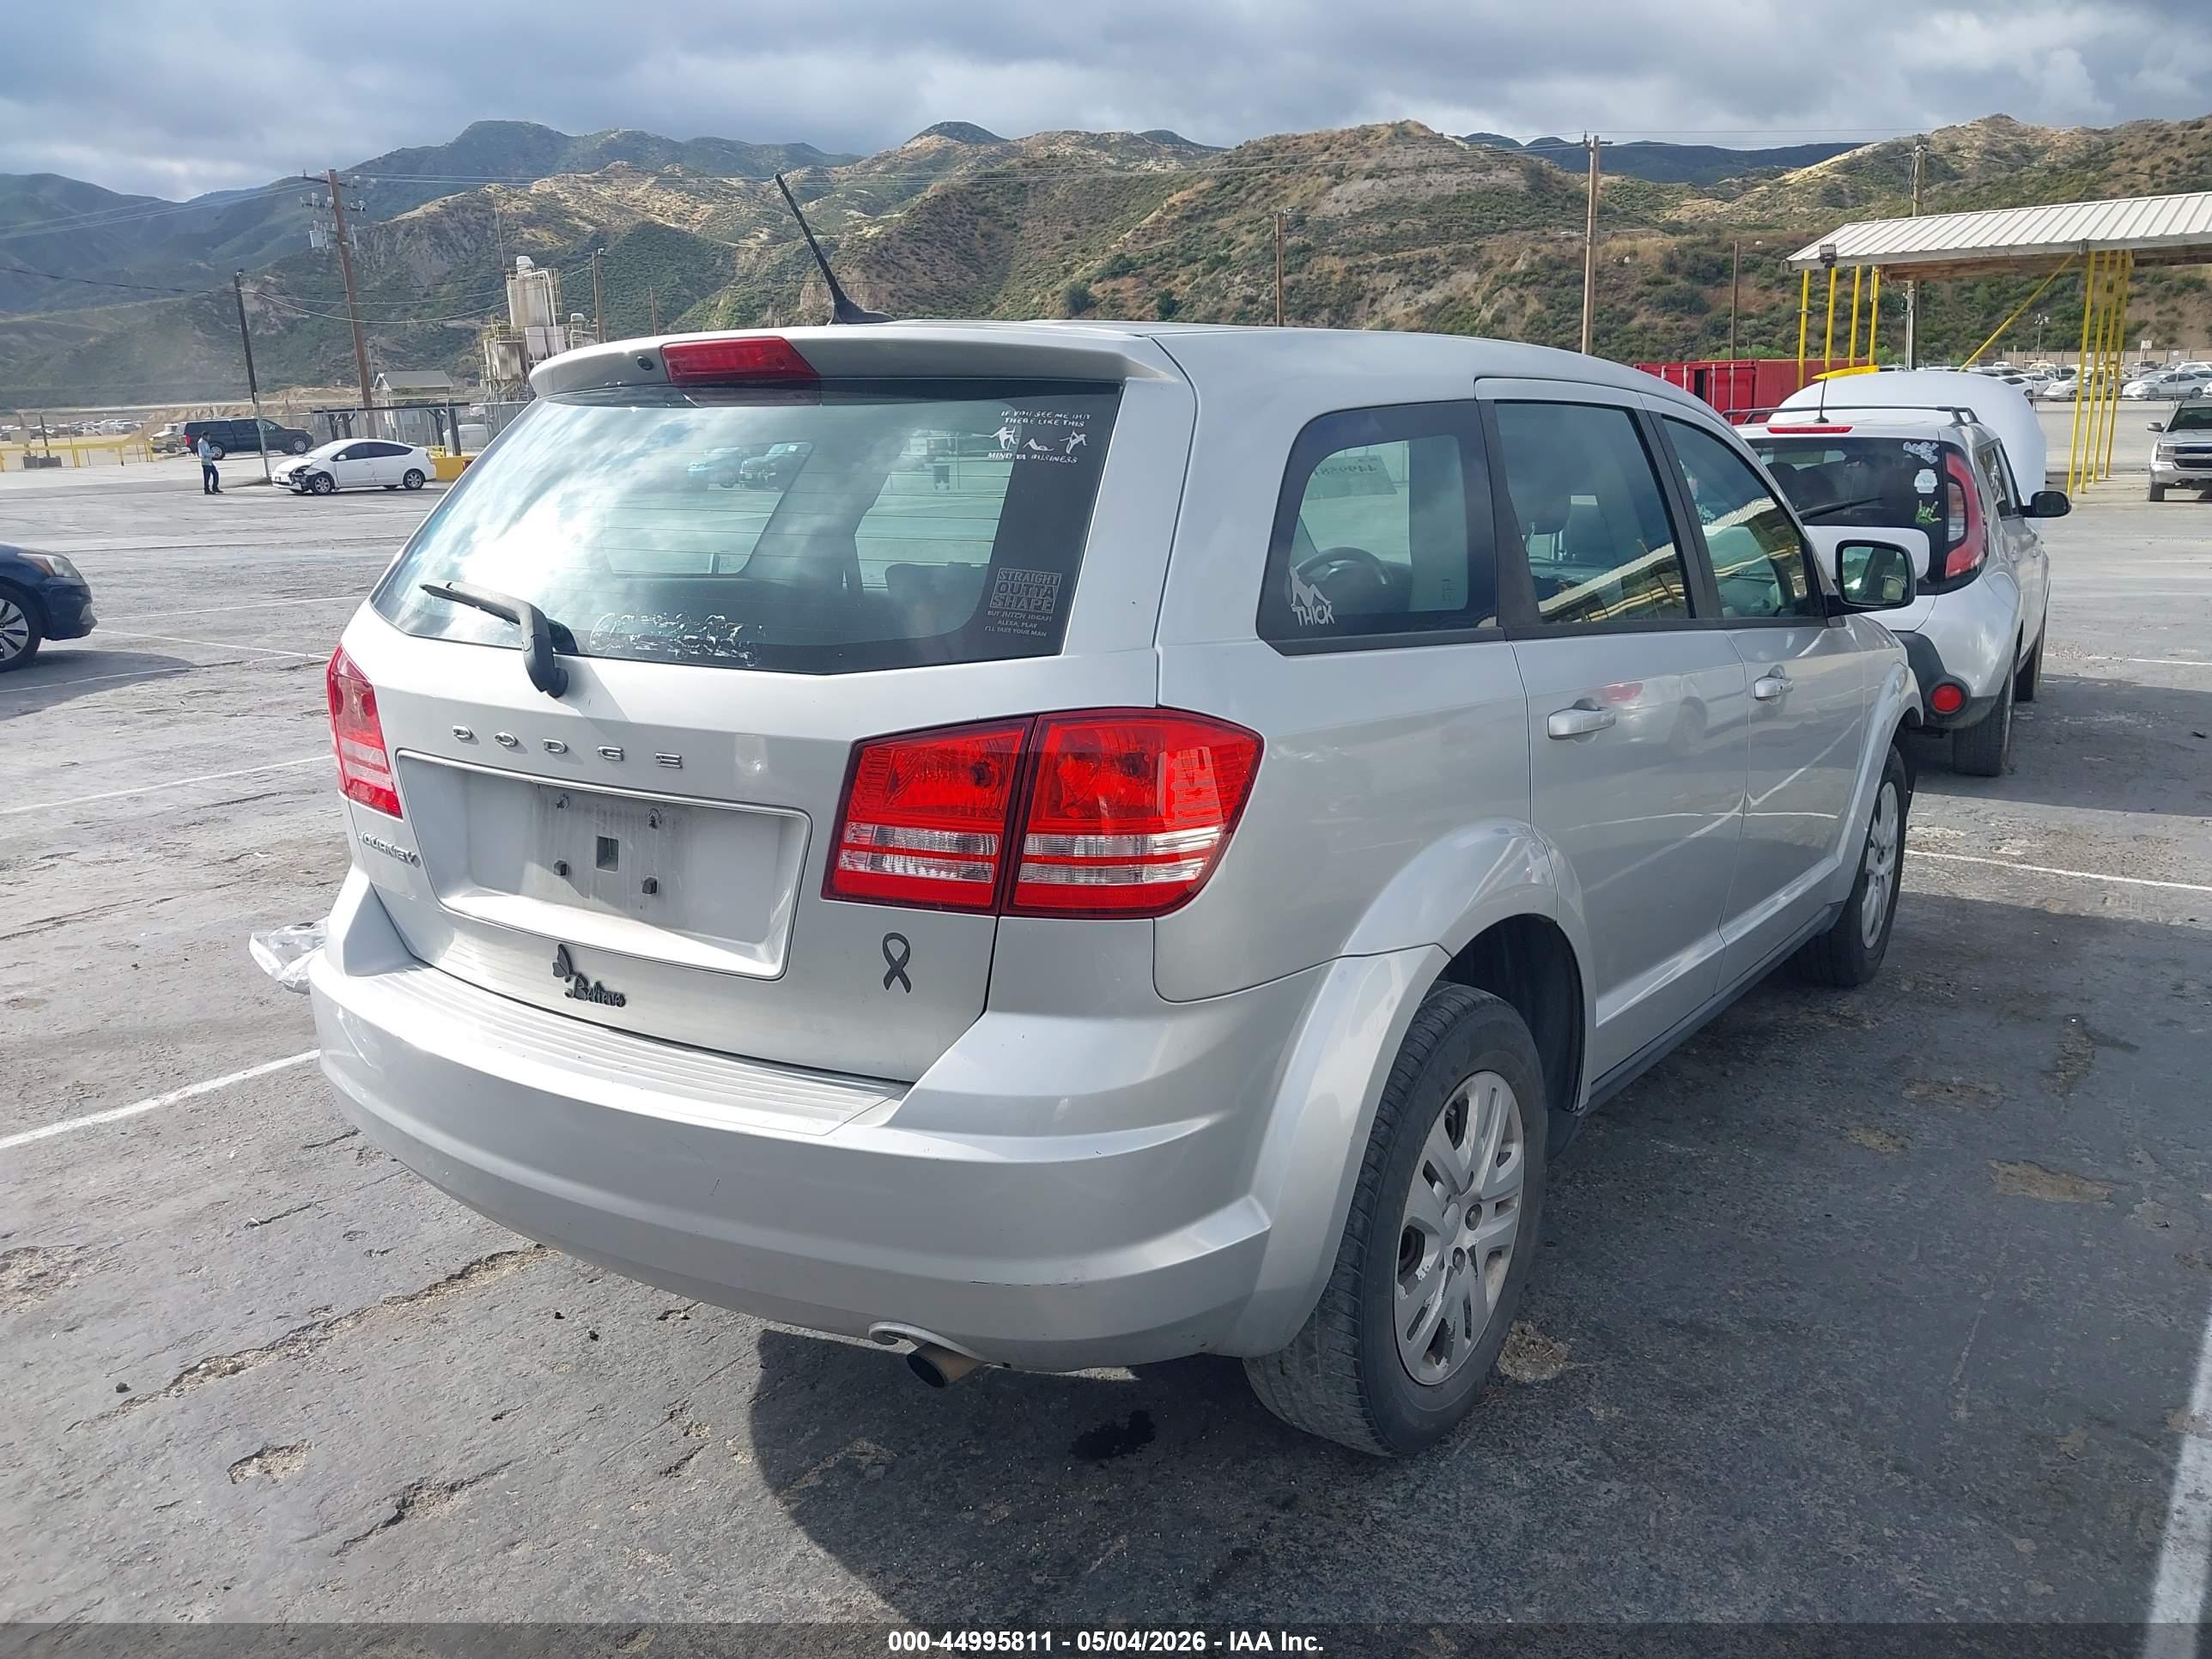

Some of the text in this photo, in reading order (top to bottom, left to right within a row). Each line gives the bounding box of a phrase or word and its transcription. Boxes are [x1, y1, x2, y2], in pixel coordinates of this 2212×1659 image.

[1063, 419, 1085, 428] THIS
[988, 452, 1012, 460] MIND
[1030, 453, 1079, 464] BUSINESS
[999, 570, 1059, 585] STRAIGHT
[997, 582, 1055, 599] OUTTA
[992, 595, 1053, 611] SHAPE
[1291, 604, 1335, 626] THICK
[453, 725, 683, 769] DODGE
